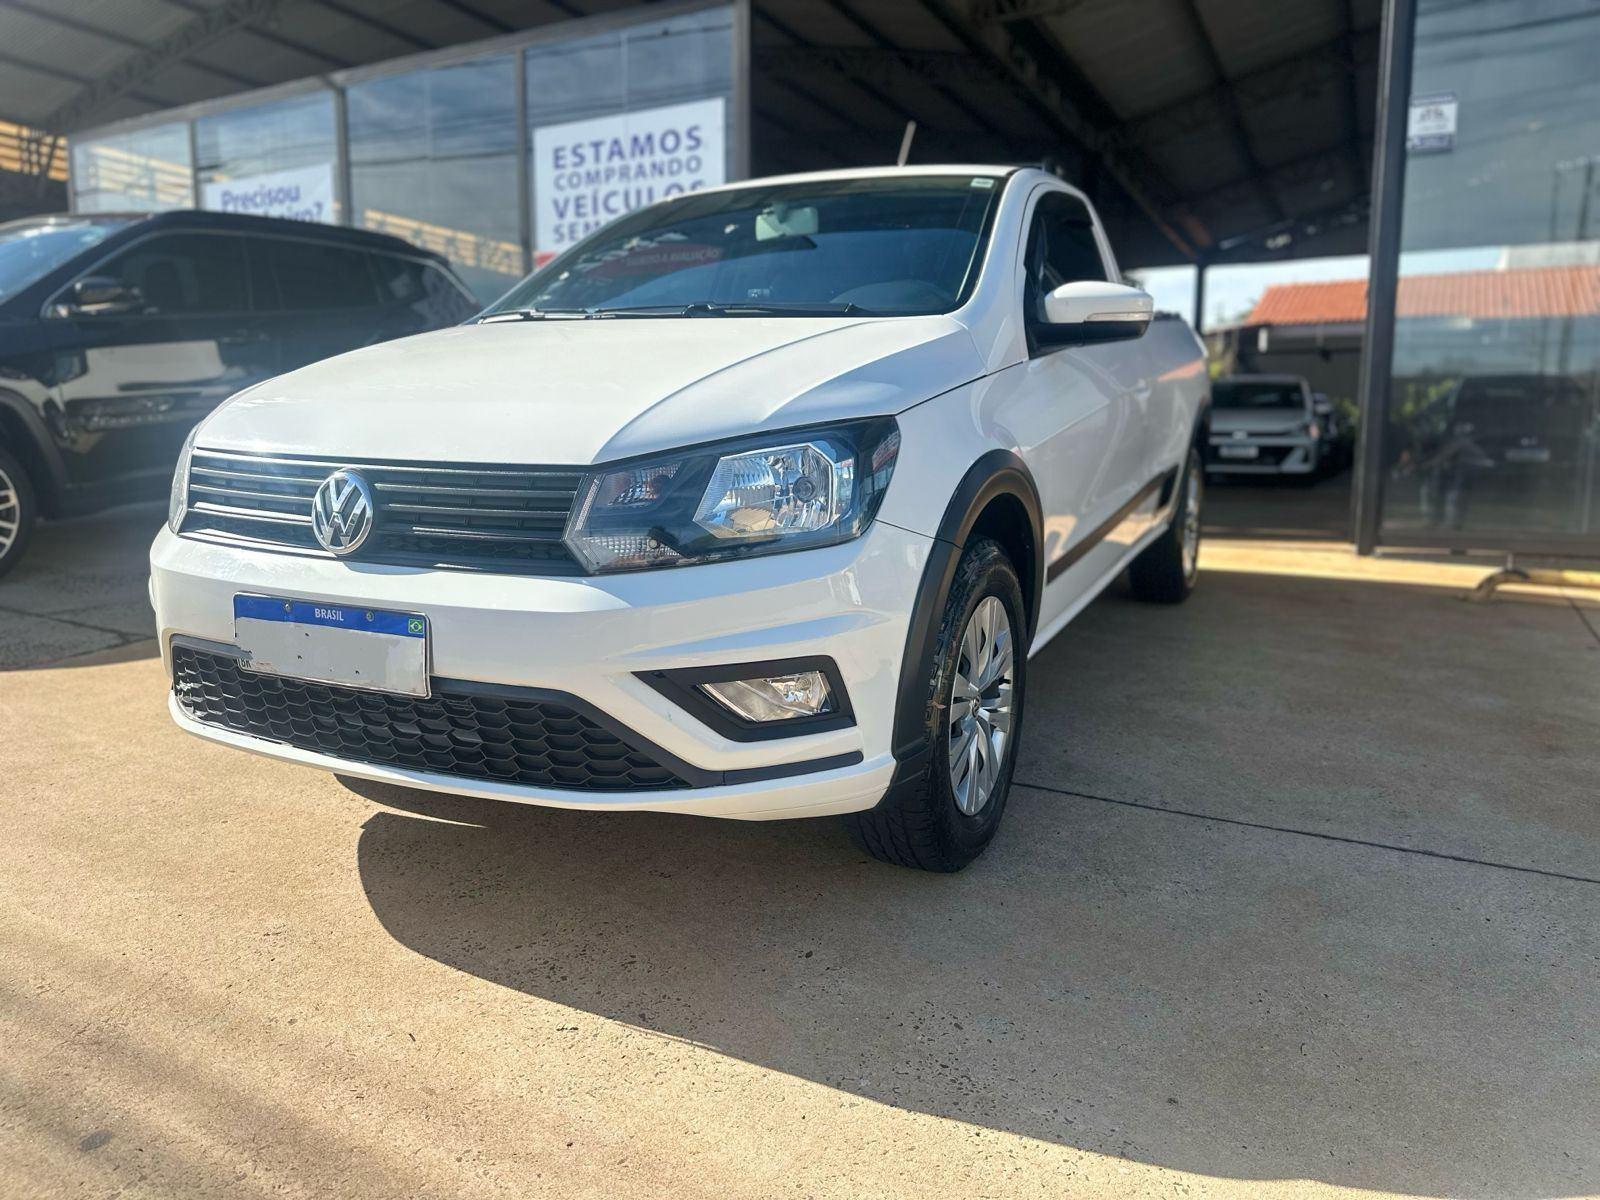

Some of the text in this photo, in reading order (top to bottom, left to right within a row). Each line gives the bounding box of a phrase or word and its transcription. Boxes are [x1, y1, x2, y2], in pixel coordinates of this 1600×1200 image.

[553, 125, 702, 170] ESTAMOS
[553, 154, 702, 192] COMPRANDO
[221, 184, 300, 211] Precisou
[314, 608, 344, 621] BRASIL
